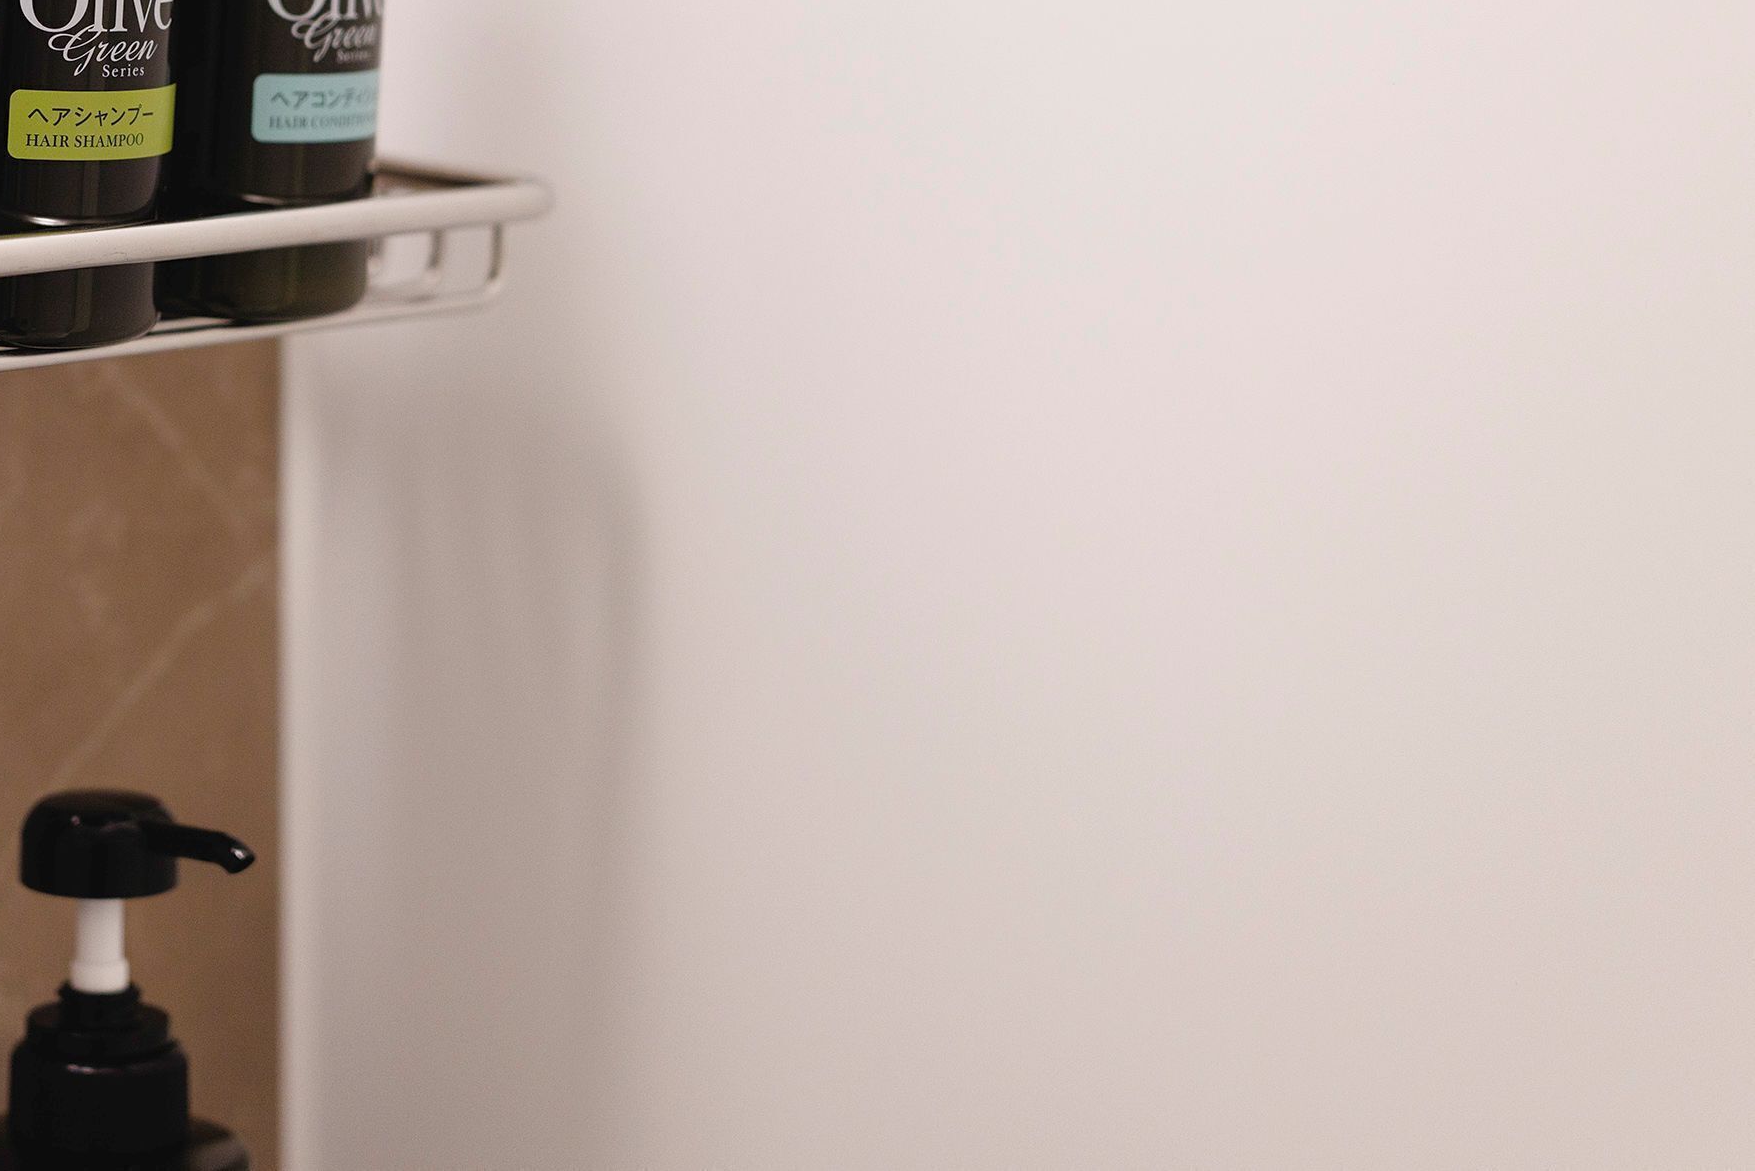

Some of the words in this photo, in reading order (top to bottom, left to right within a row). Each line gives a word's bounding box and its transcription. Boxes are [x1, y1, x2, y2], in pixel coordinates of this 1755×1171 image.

[47, 23, 159, 77] Green
[101, 63, 145, 78] Series
[27, 103, 155, 127] ヘアシャンプー
[25, 133, 70, 148] HAIR
[73, 132, 145, 149] SHAMPOO
